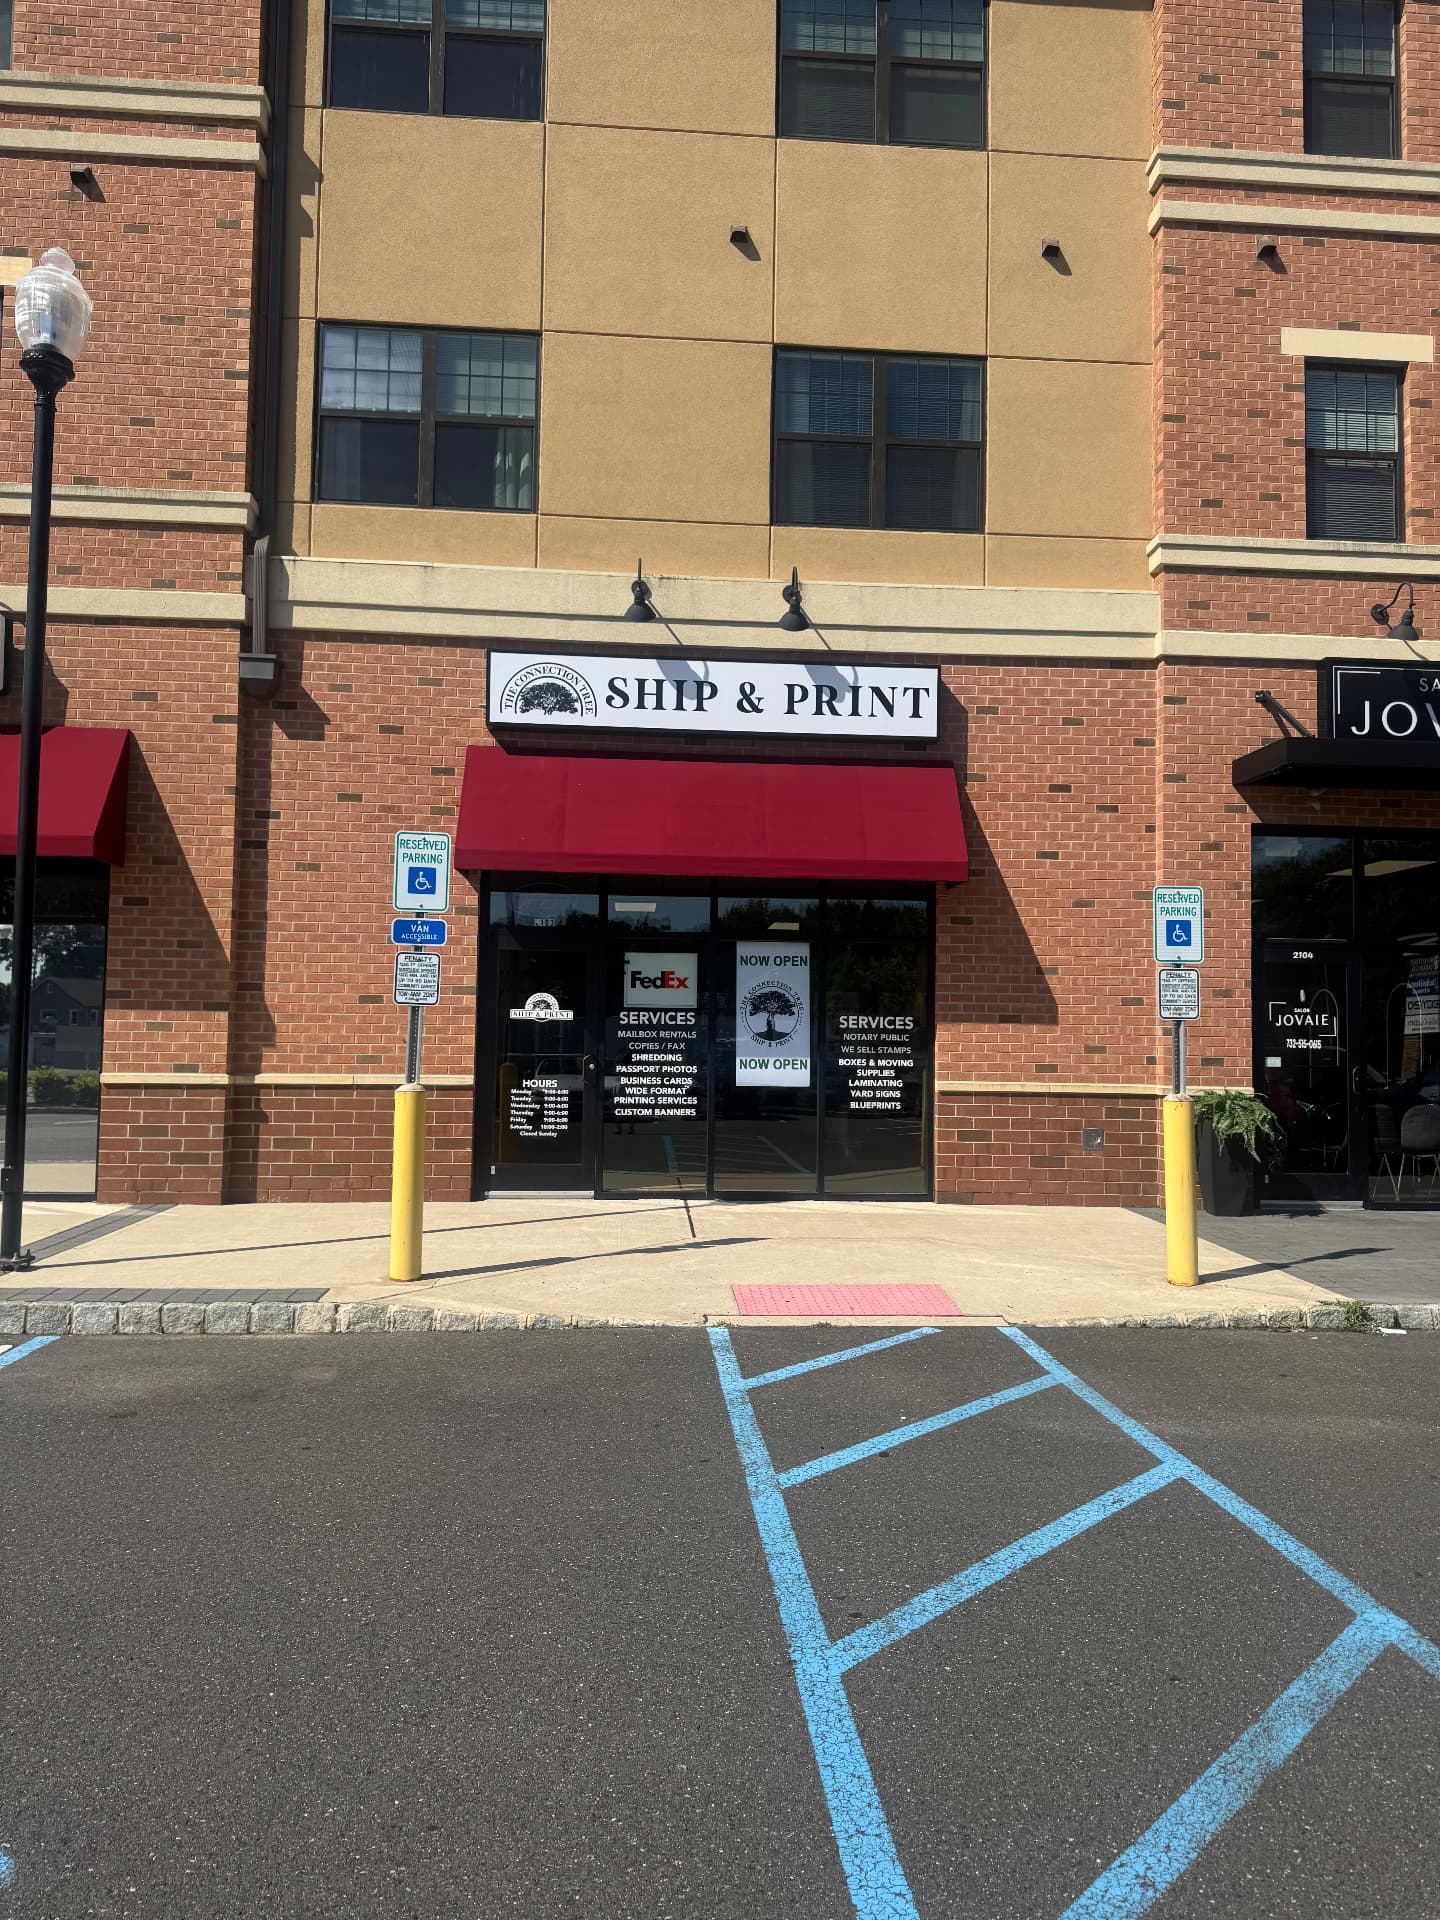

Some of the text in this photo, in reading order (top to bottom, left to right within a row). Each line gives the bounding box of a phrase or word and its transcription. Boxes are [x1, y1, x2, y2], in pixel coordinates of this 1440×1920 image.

[505, 666, 594, 715] THE CONNECTION TREE
[606, 677, 930, 719] SHIP & PRINT
[399, 839, 447, 851] RESERVED
[402, 853, 443, 864] PARKING
[1157, 894, 1200, 904] RESERVED
[1160, 907, 1197, 917] PARKING
[410, 925, 429, 933] VAN
[1292, 951, 1314, 959] 2104
[740, 955, 808, 967] NOW OPEN
[630, 970, 689, 989] FedEx
[748, 980, 793, 995] CONNECTION
[619, 1011, 696, 1025] SERVICES
[839, 1015, 914, 1029] SERVICES
[1275, 1014, 1329, 1026] JOVAIE
[617, 1030, 697, 1039] MAILBOX RENTALS
[843, 1033, 879, 1041] NOTARY
[628, 1042, 660, 1050] COPIES
[661, 1042, 666, 1050] /
[841, 1045, 912, 1054] WE SELL STAMPS
[631, 1054, 683, 1062] SHREDDING
[838, 1058, 914, 1067] BOXES & MOVING
[739, 1058, 808, 1070] NOW OPEN
[616, 1065, 698, 1073] PASSPORT PHOTOS
[856, 1069, 896, 1077] SUPPLIES
[522, 1079, 558, 1088] HOURS
[620, 1077, 693, 1085] BUSINESS CARDS
[848, 1079, 903, 1087] LAMINATING
[625, 1087, 688, 1095] WIDE FORMAT
[875, 1090, 901, 1098] SIGNS
[510, 1095, 532, 1103] Tuesday
[657, 1097, 698, 1105] SERVICES
[850, 1101, 902, 1110] BLUEPRINTS
[615, 1108, 653, 1116] CUSTOM
